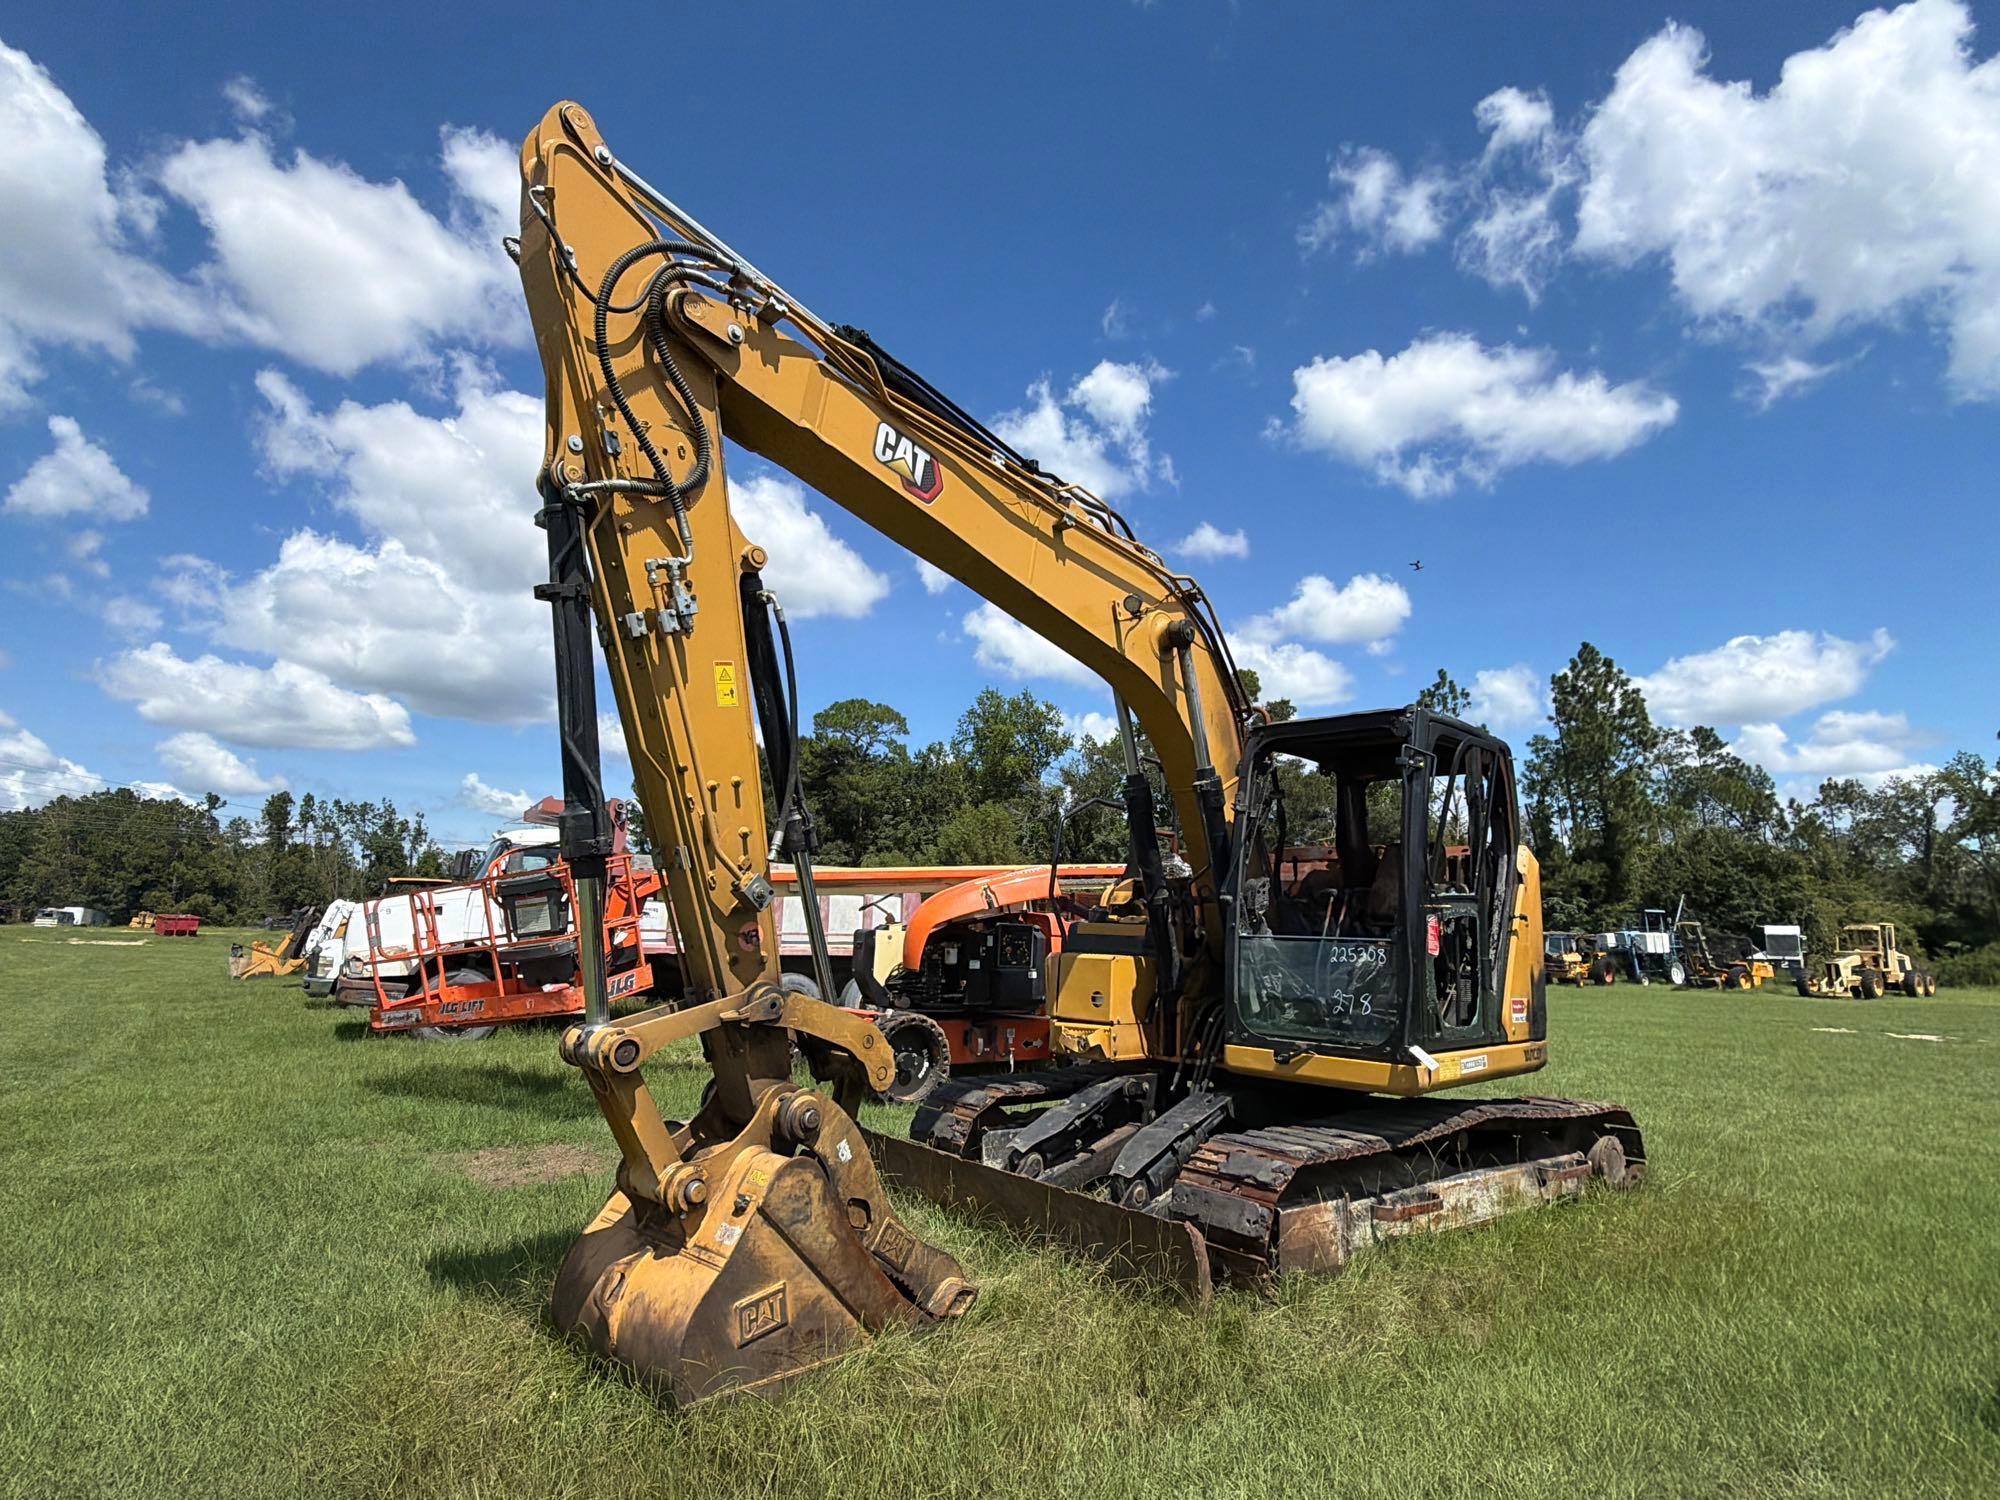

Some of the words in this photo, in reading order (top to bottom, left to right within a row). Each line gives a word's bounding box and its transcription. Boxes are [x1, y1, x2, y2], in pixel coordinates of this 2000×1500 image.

[874, 422, 931, 488] CAT
[608, 973, 635, 996] JLG
[440, 1003, 458, 1014] JLG
[461, 1001, 485, 1013] LIFT
[742, 1292, 783, 1339] CAT
